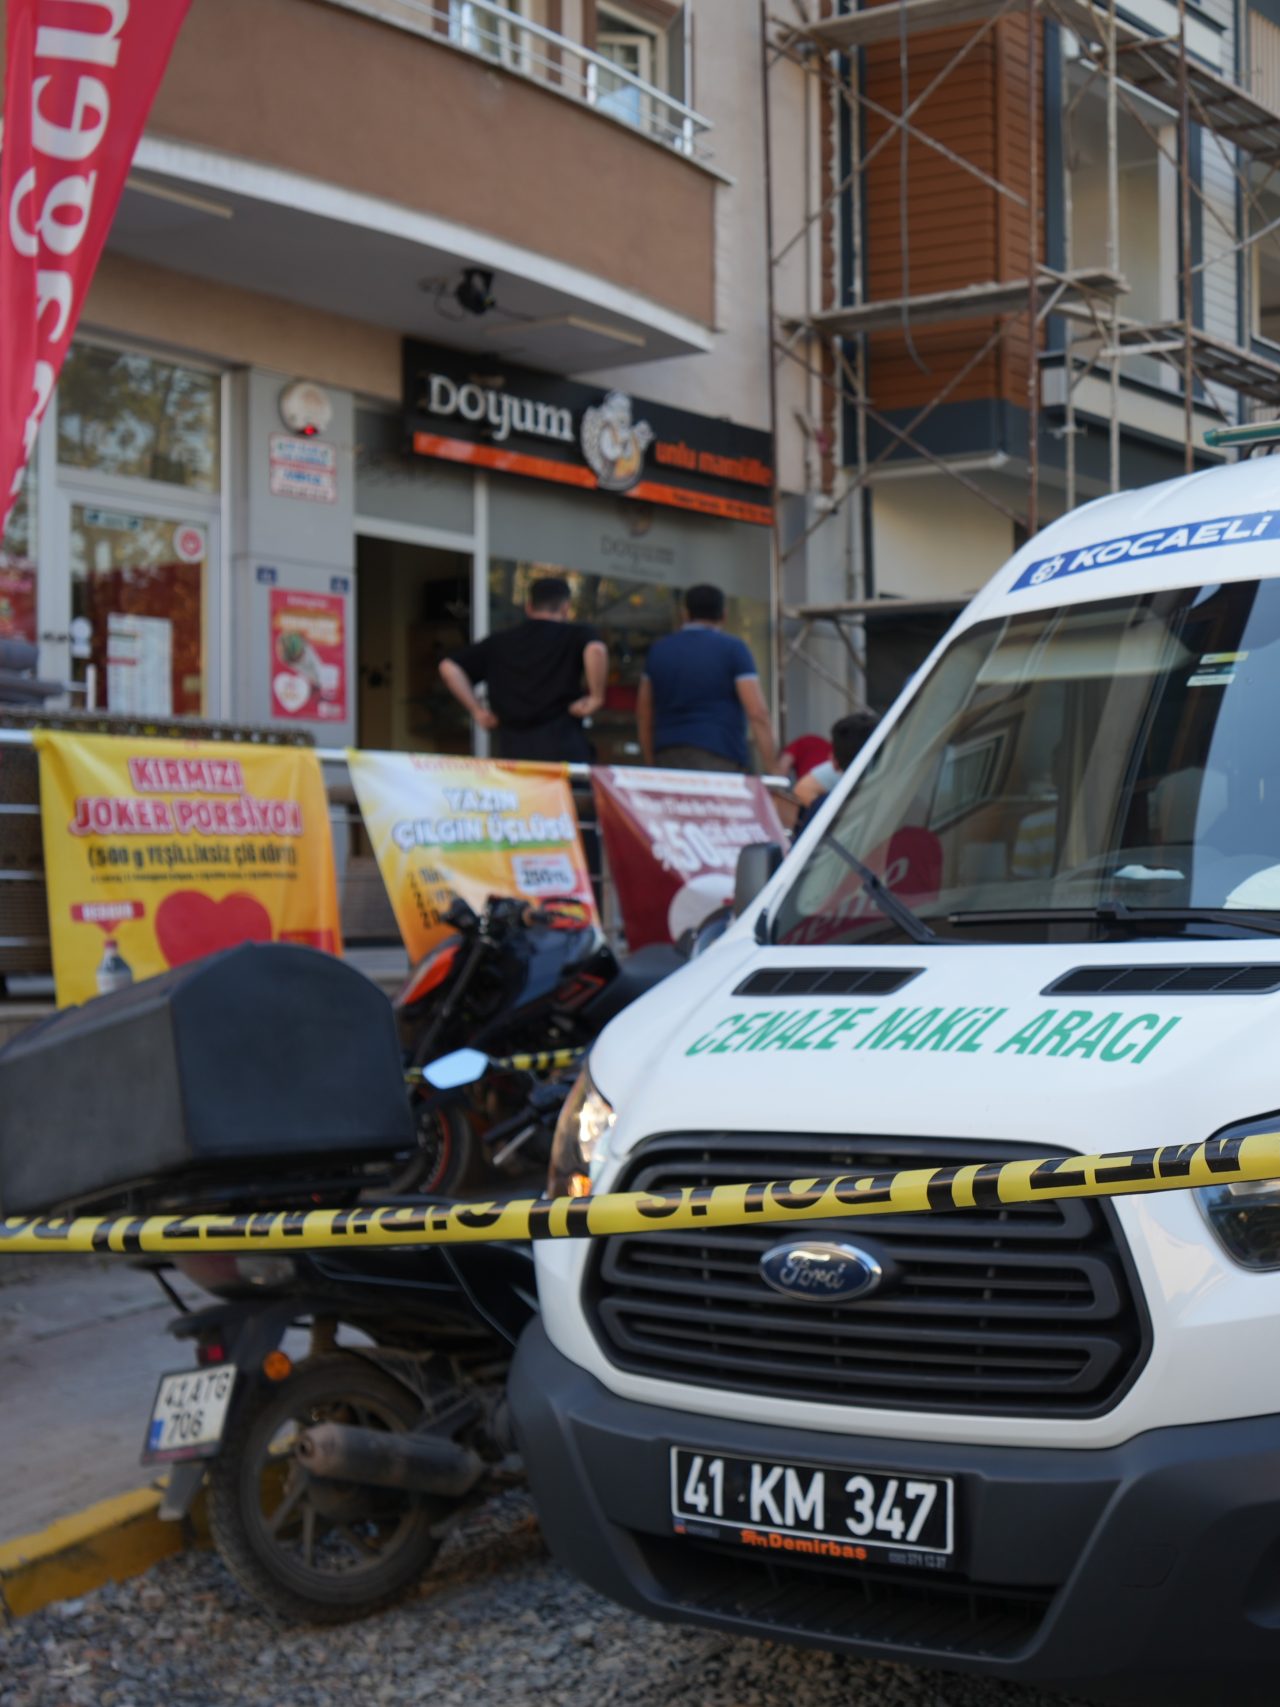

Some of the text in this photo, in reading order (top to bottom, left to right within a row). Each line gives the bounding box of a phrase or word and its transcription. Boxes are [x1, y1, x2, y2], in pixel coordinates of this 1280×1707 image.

[1071, 515, 1270, 571] KOCAELİ
[131, 758, 243, 791] KIRMIZI
[73, 798, 172, 833] JOKER
[685, 1005, 1183, 1065] CENAZE NAKİL ARACI
[779, 1249, 848, 1290] Ford
[683, 1455, 938, 1543] 41 KM 347
